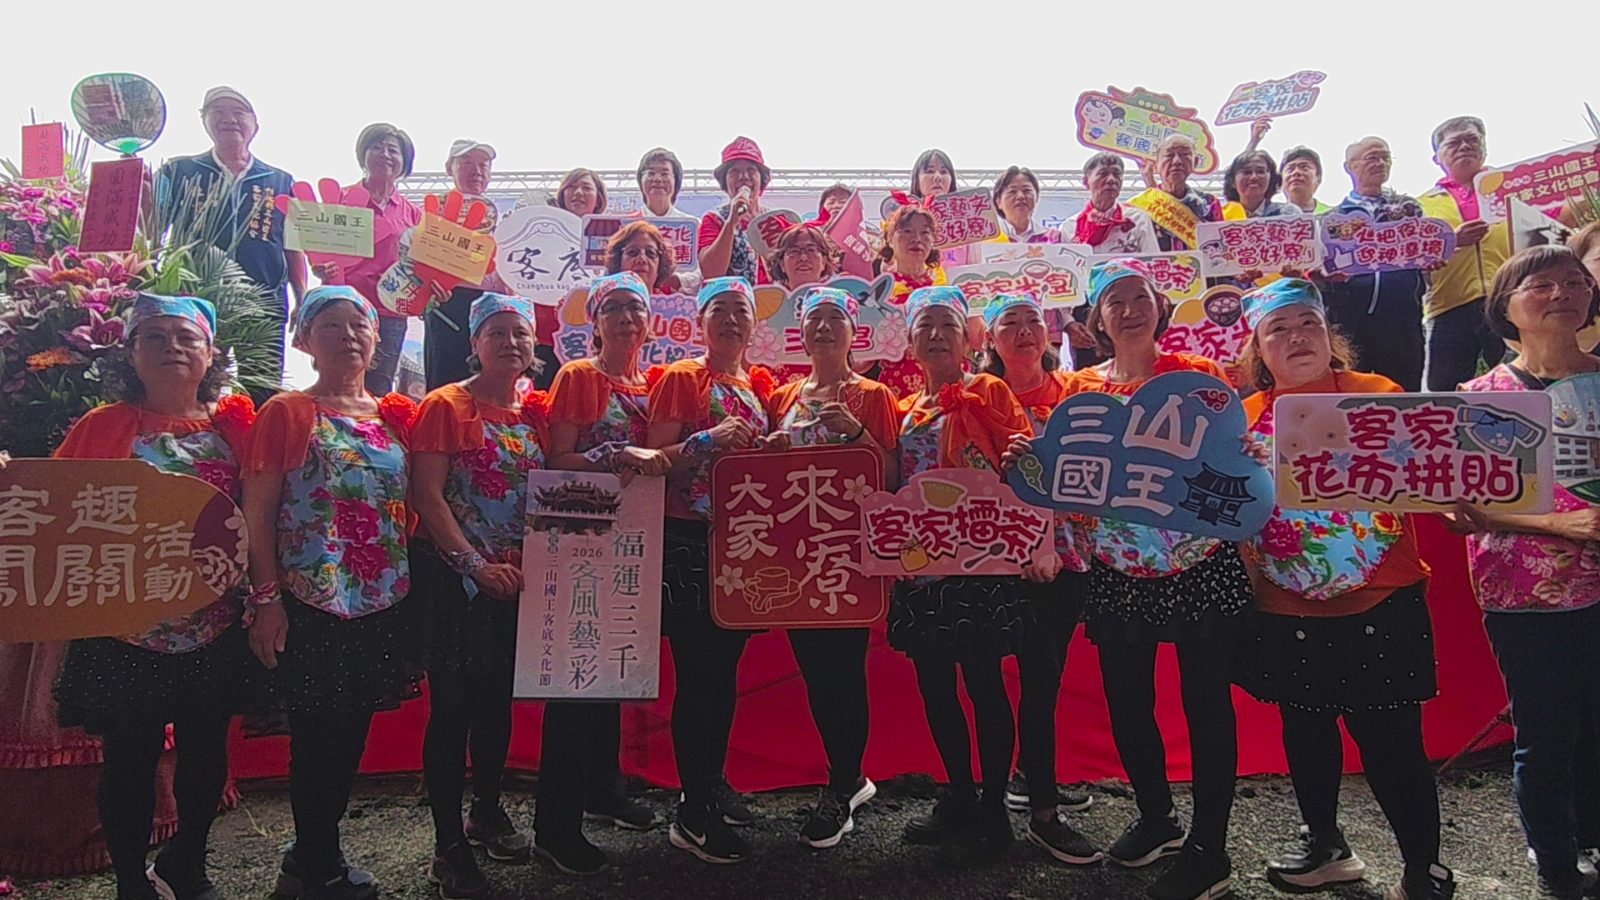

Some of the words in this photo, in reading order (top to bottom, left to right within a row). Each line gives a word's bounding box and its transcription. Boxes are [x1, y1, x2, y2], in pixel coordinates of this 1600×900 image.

[1533, 155, 1598, 182] 三山國王
[296, 210, 366, 227] 三山國王
[426, 225, 485, 256] 三山國王
[1059, 394, 1210, 461] 三山
[1345, 403, 1456, 451] 客家
[1051, 453, 1175, 518] 國王
[1292, 450, 1514, 498] 花布拼貼
[725, 475, 778, 561] 大家
[866, 498, 1048, 566] 客家擂茶
[142, 520, 196, 603] 活動
[572, 547, 603, 558] 2026
[568, 560, 603, 690] 客風藝彩
[608, 530, 646, 680] 福運三千
